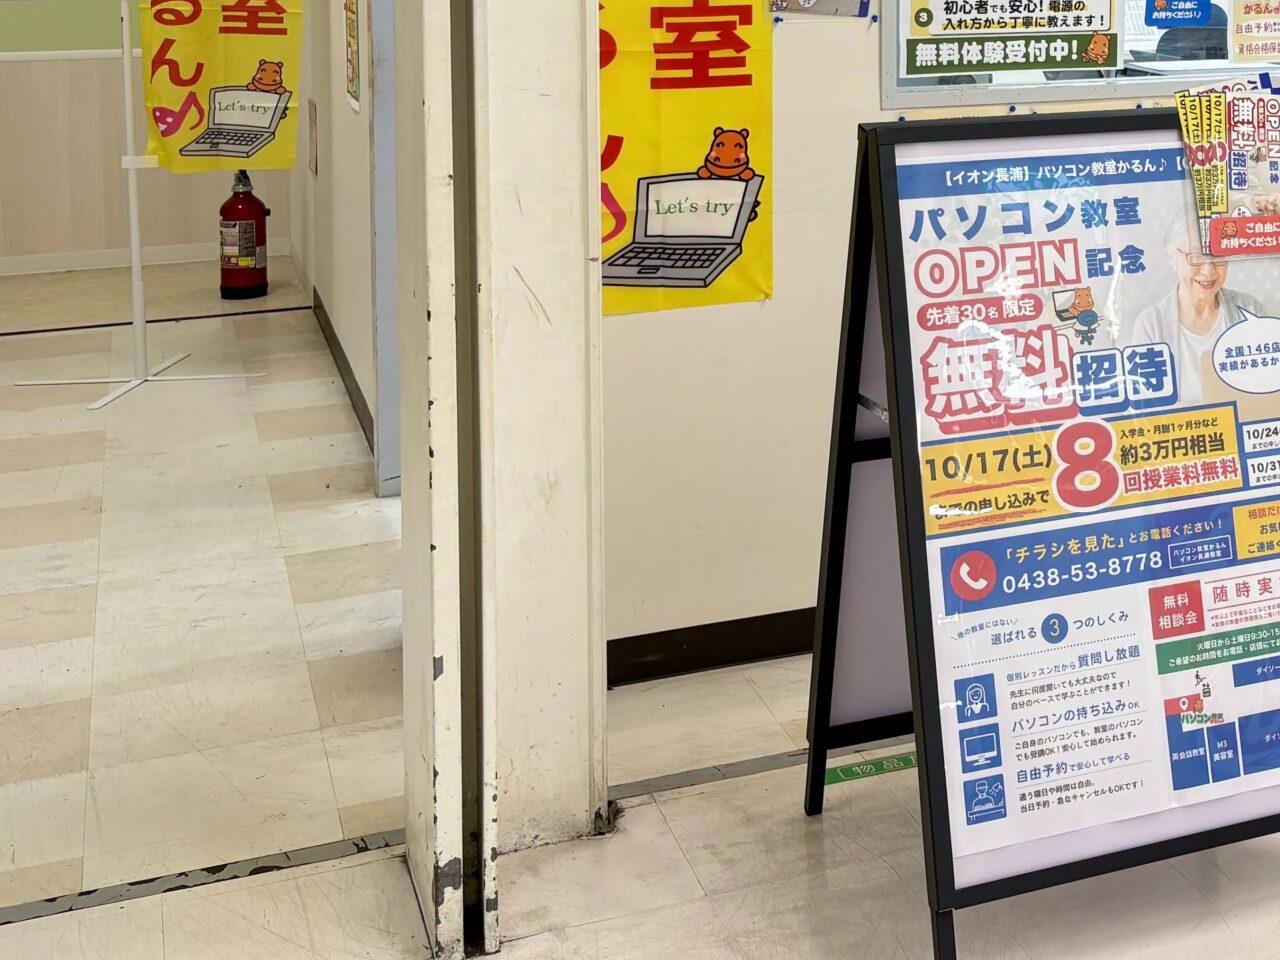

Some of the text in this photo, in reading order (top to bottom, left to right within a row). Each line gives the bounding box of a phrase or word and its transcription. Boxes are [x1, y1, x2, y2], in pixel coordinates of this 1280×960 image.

[1171, 1, 1198, 9] ご自由に
[916, 39, 1078, 67] 無料体験受付中!
[217, 100, 271, 115] Let's try
[1232, 97, 1256, 151] 無料
[1266, 99, 1280, 159] OPEN
[1230, 151, 1248, 190] 招待
[654, 196, 734, 216] Let's try
[908, 196, 1142, 242] パソコン教室
[914, 238, 1146, 298] OPEN 記念
[920, 321, 1170, 424] 無料 招待
[925, 421, 1226, 508] 10/17(土) 8 約3万円相当
[1123, 456, 1239, 494] 回授業料無料
[1002, 550, 1163, 594] 0438-53-8778
[1163, 592, 1189, 609] 無料
[1158, 611, 1198, 630] 相談会
[1256, 664, 1280, 675] ダイソー
[1172, 748, 1205, 762] 英会話教室
[1213, 750, 1234, 762] 美容室
[1217, 741, 1228, 749] M3
